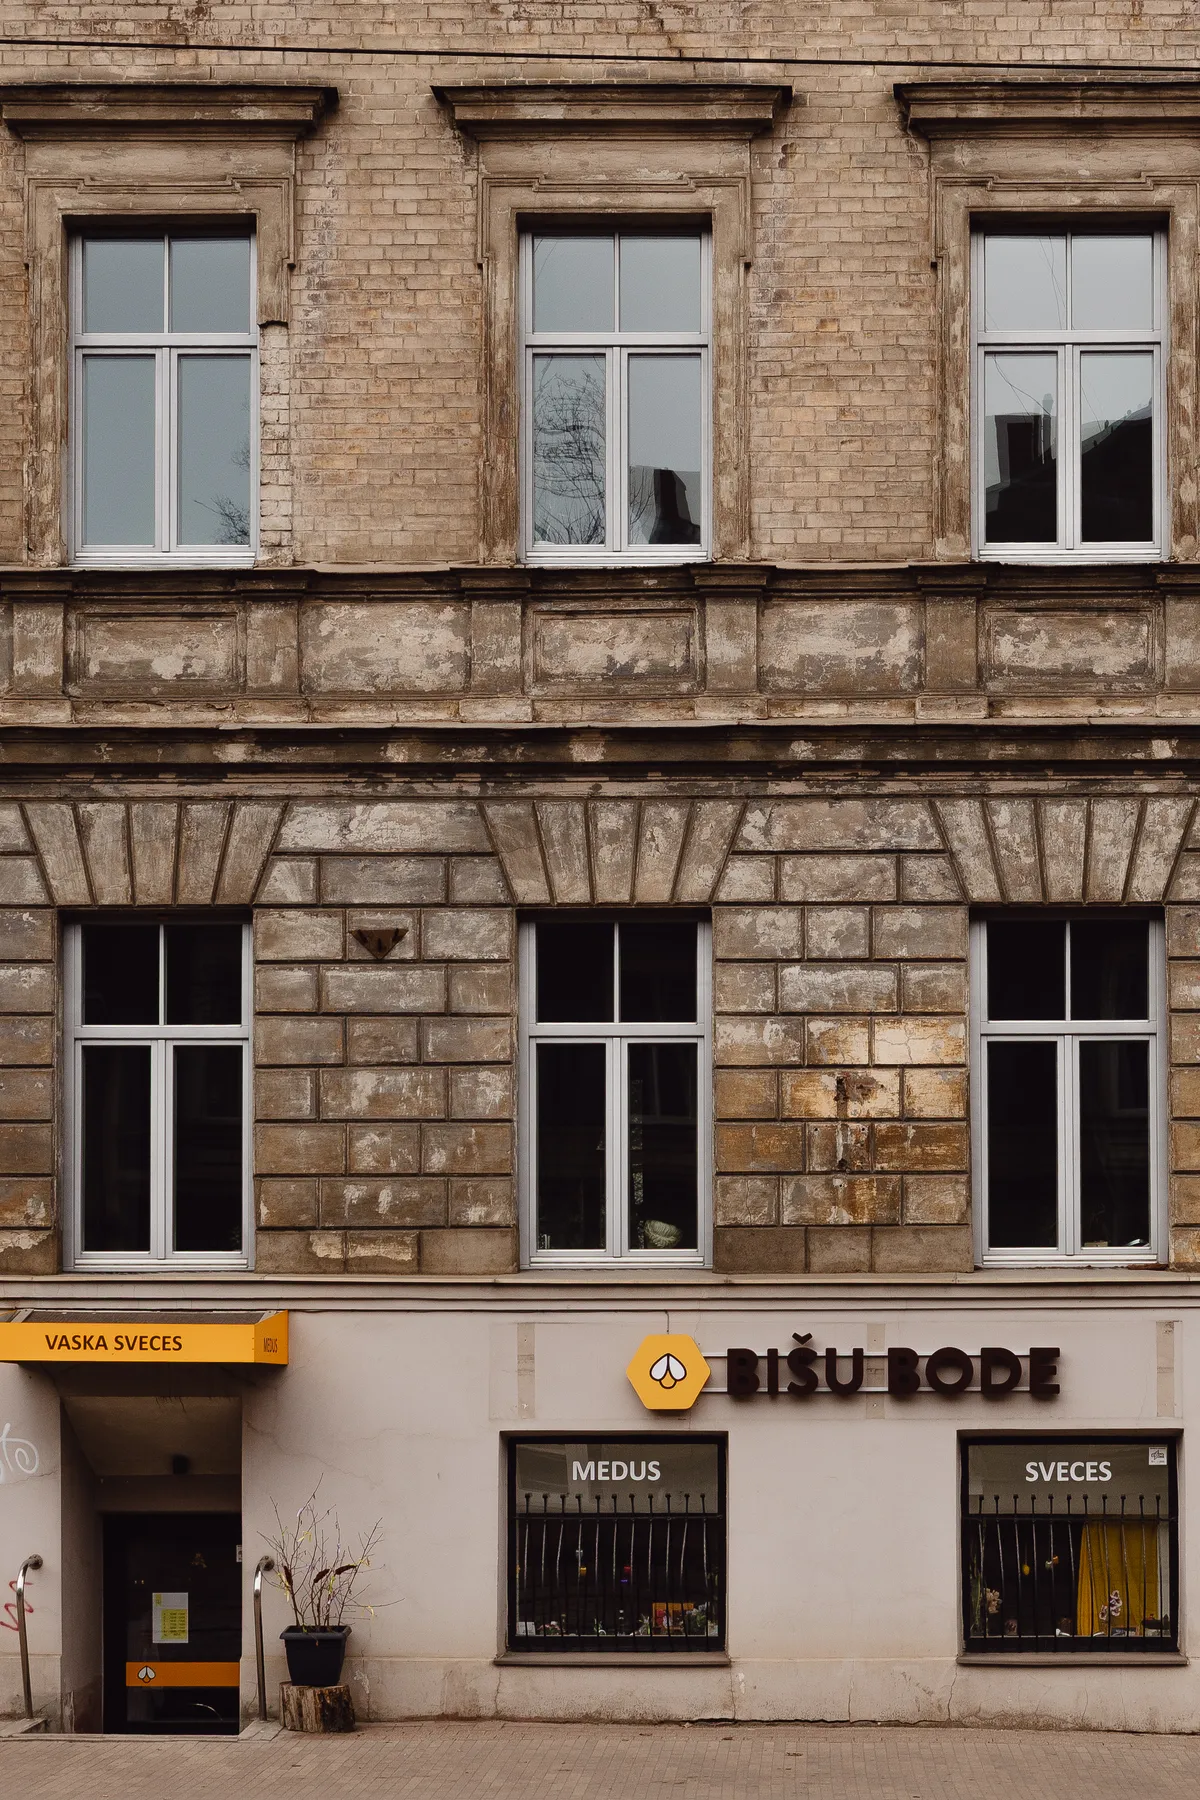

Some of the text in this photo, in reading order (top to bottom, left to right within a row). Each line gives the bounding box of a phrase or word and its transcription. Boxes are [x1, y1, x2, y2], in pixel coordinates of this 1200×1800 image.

[45, 1335, 182, 1351] VASKA SVECES
[727, 1332, 1060, 1395] BIŠU BODE
[572, 1460, 661, 1481] MEDUS
[1025, 1461, 1112, 1482] SVECES
